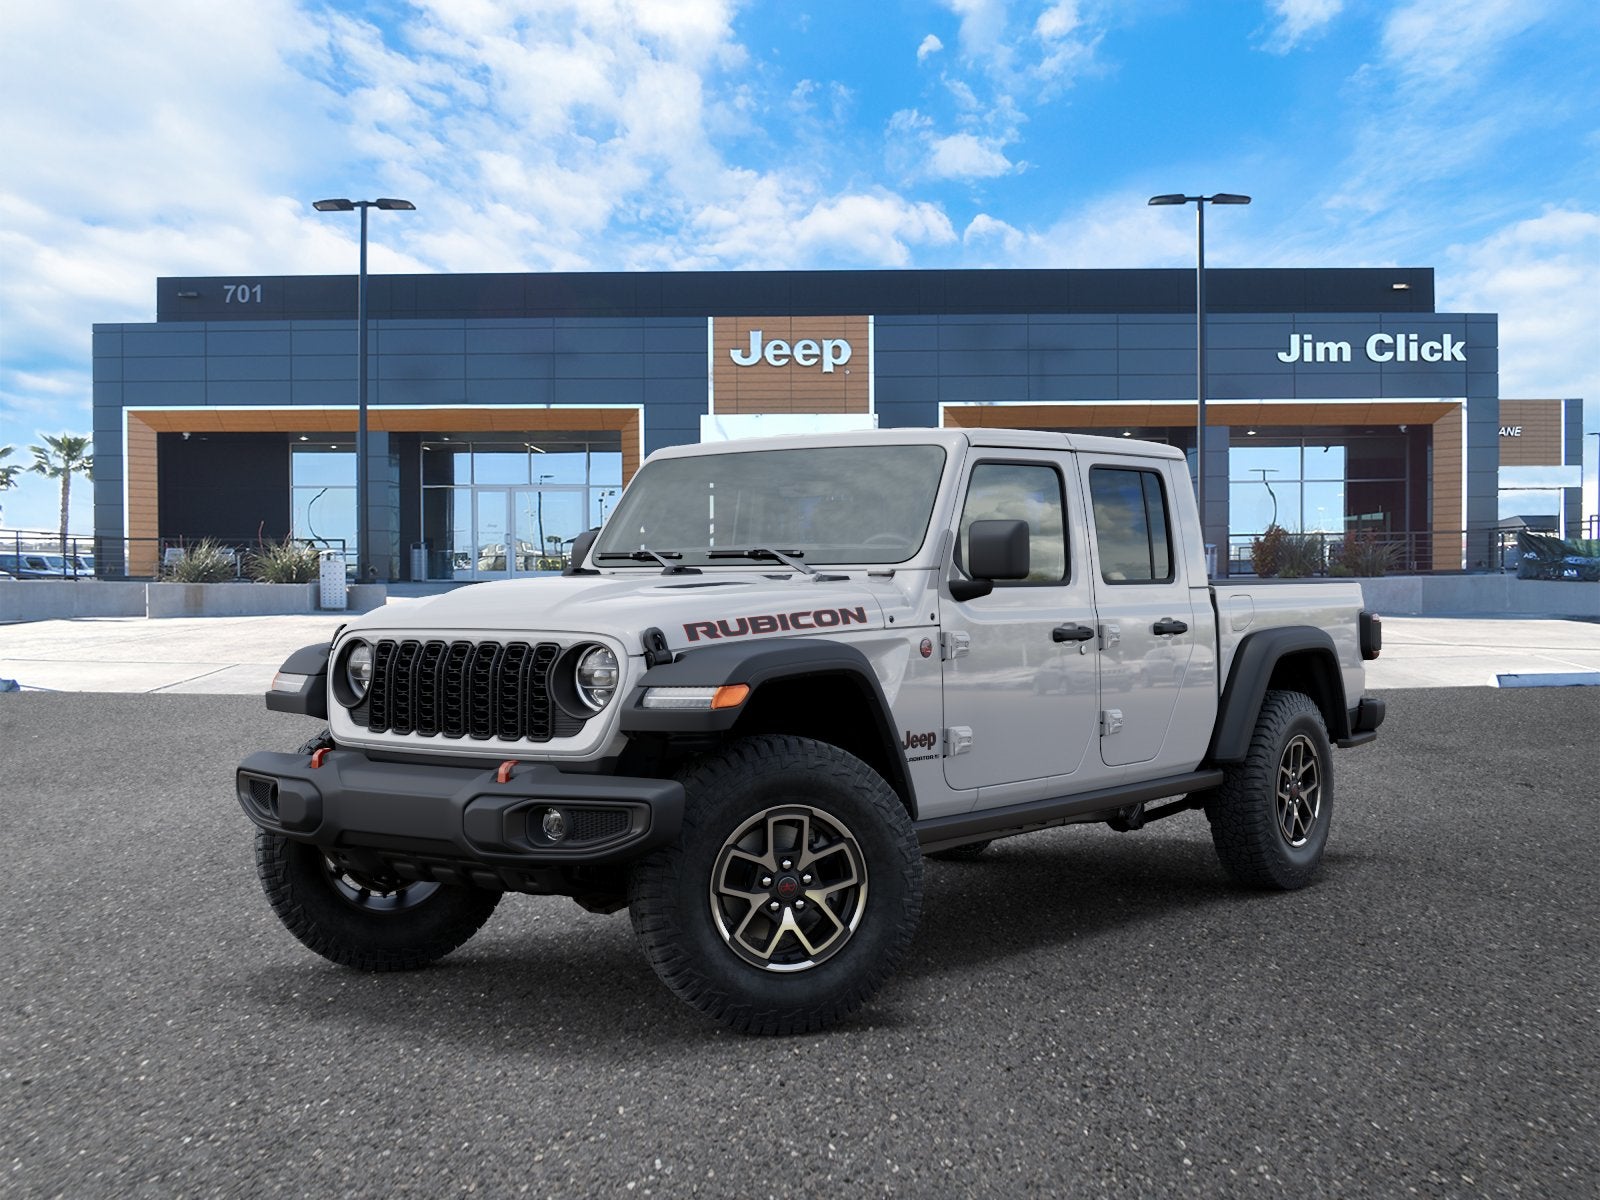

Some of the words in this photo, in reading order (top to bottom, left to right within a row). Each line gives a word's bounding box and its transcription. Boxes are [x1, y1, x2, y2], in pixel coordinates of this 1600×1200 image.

[223, 284, 262, 304] 701
[729, 330, 852, 374] Jeep
[1277, 333, 1352, 363] Jim
[1365, 332, 1467, 363] Click
[1498, 426, 1523, 437] ANE
[682, 606, 868, 643] RUBICON
[901, 730, 937, 751] Jeep
[905, 754, 934, 763] LADIATOR
